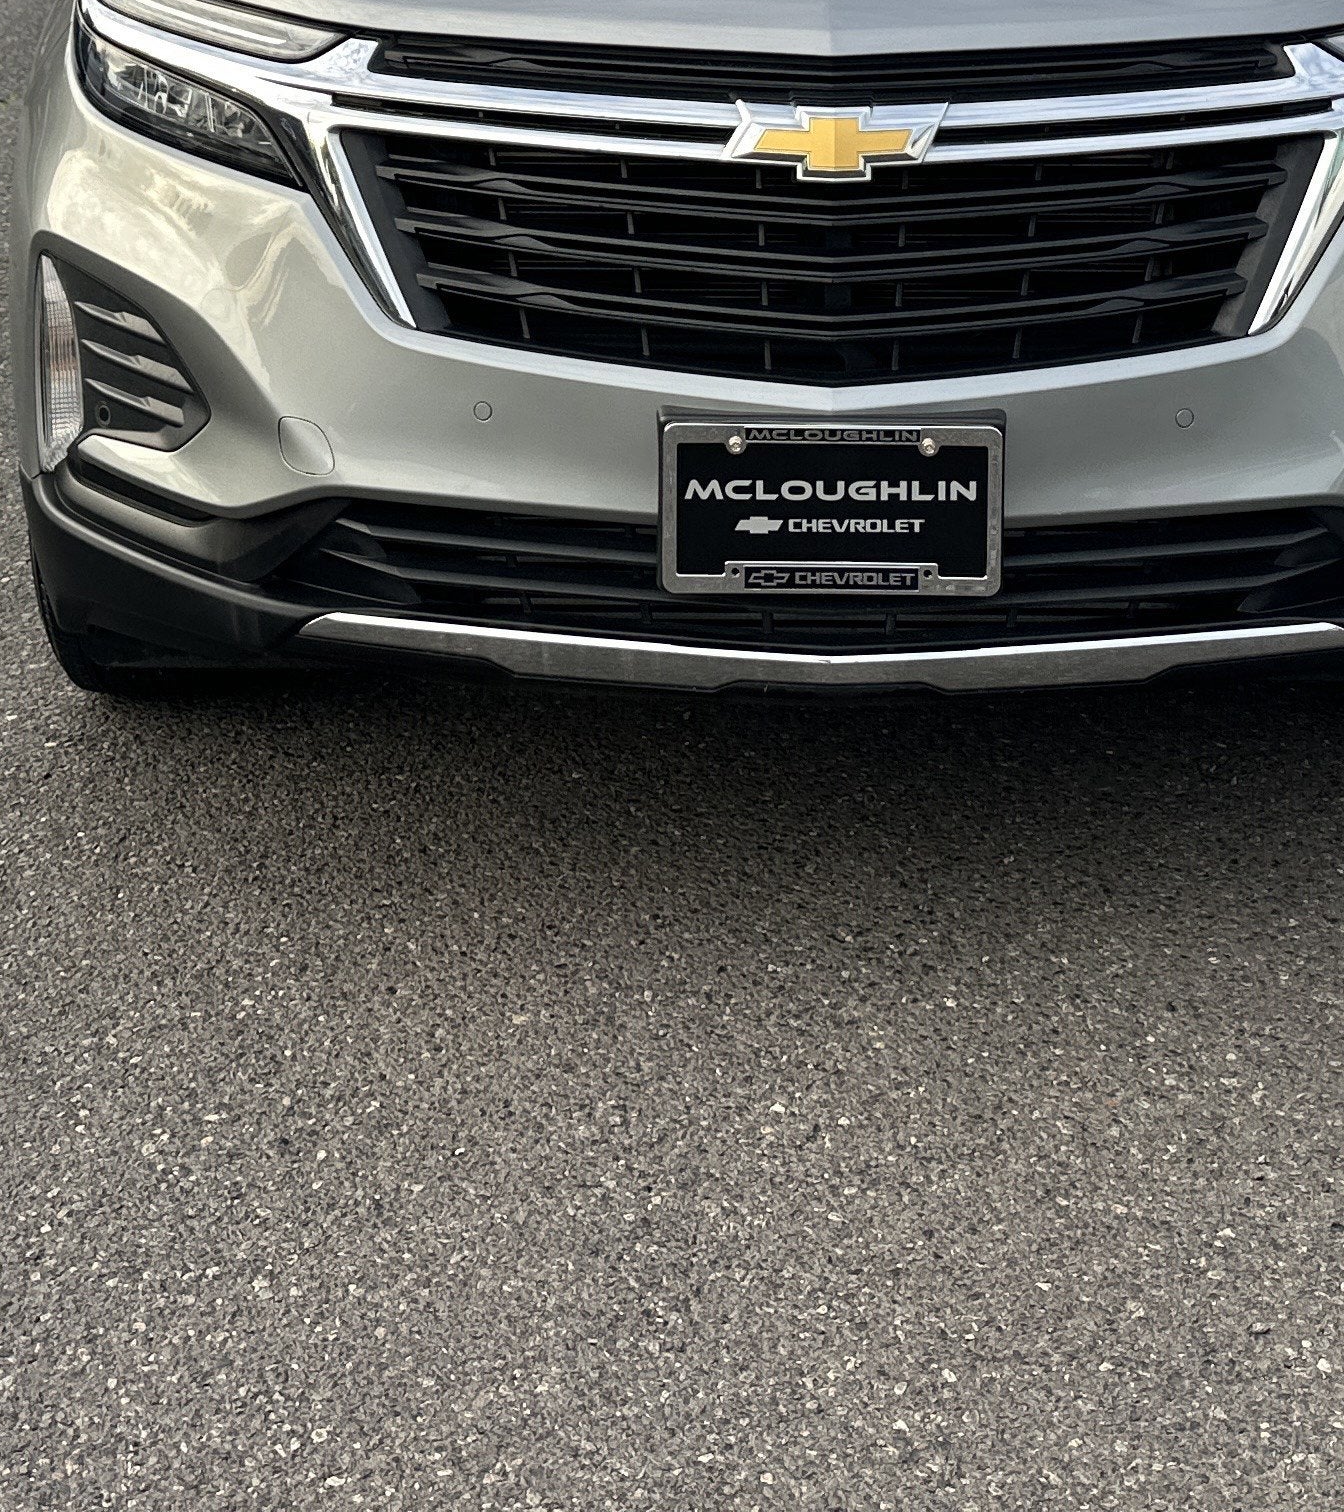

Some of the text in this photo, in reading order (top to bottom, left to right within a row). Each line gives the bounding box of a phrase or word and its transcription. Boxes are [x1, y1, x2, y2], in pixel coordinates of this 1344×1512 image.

[748, 429, 919, 442] MCLOUGHLIN
[684, 479, 977, 501] MCLOUGHLIN
[788, 518, 925, 533] CHEVROLET
[794, 572, 915, 586] CHEVROLET
